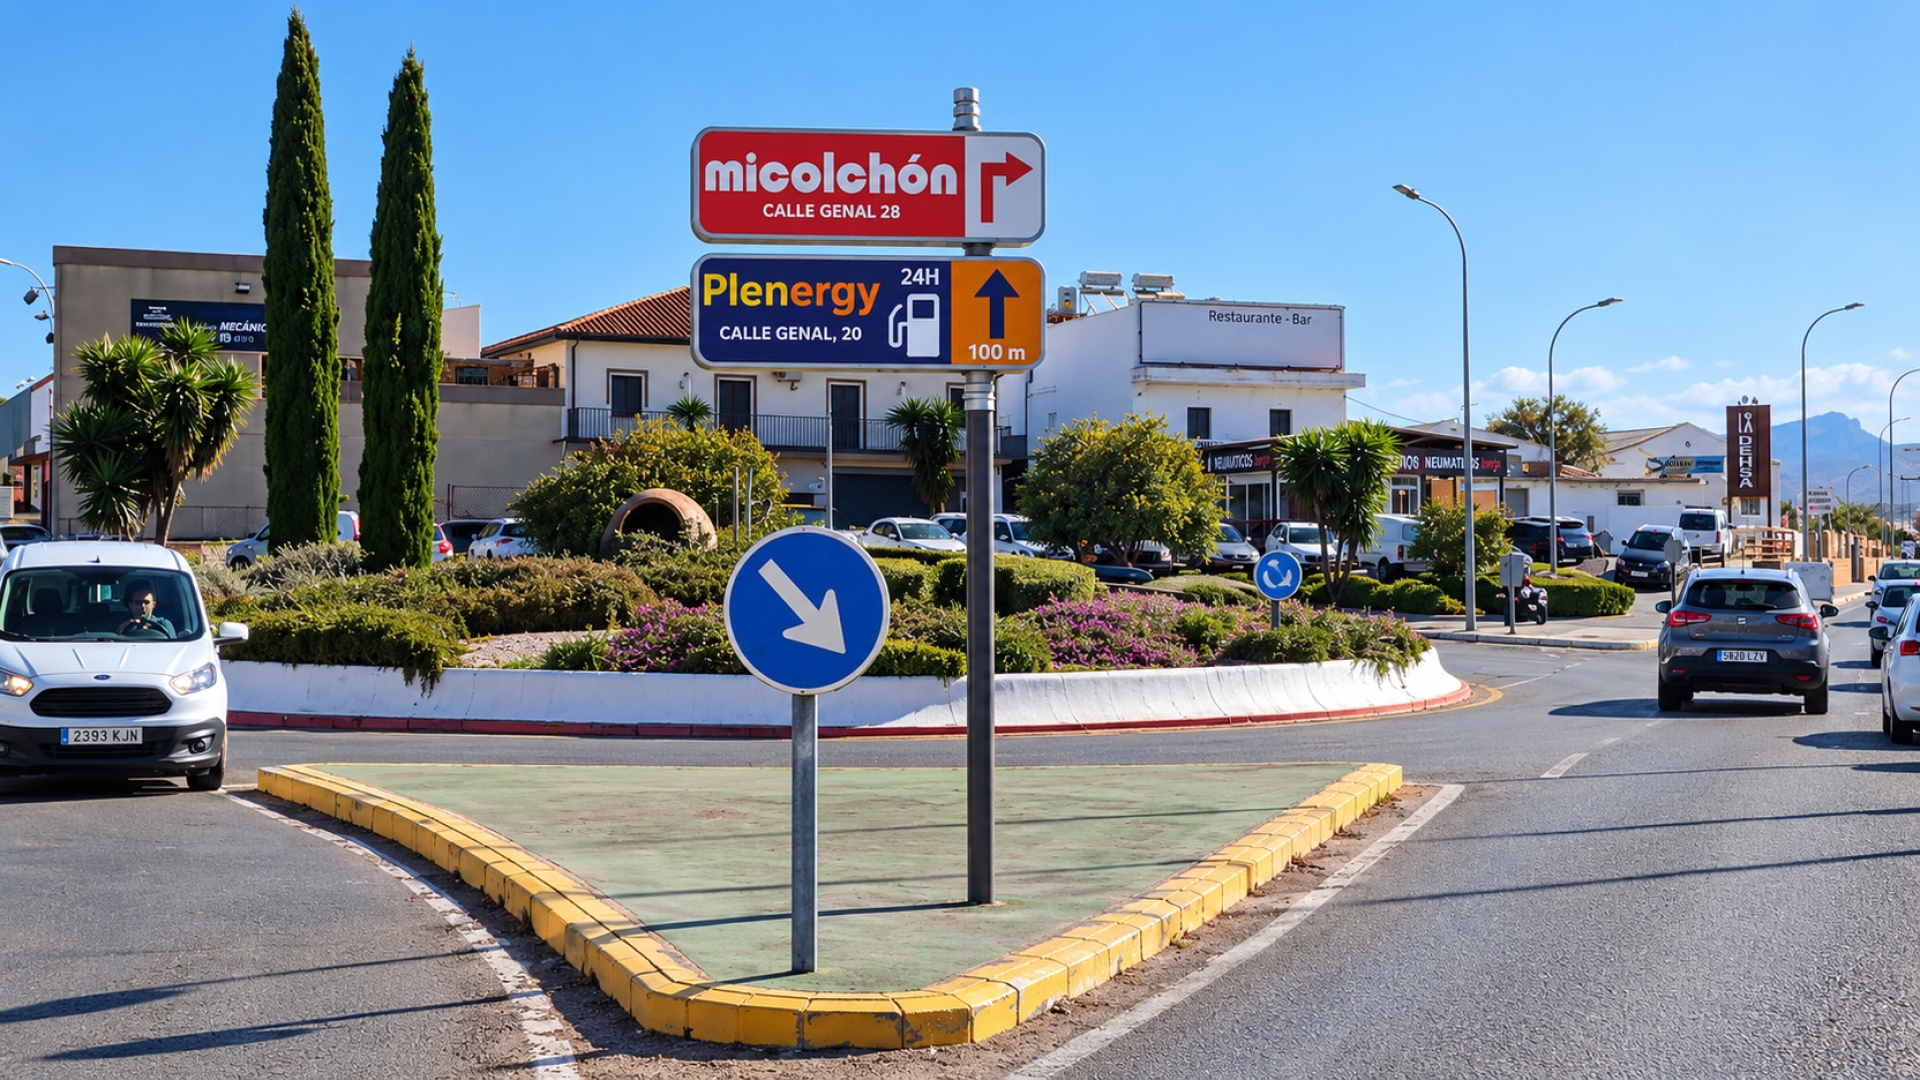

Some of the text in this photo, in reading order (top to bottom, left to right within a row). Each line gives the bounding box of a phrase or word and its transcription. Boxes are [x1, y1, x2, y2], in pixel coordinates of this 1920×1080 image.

[704, 152, 958, 195] micolchón
[763, 203, 901, 219] CALLE GENAL 28
[901, 268, 940, 286] 24H
[703, 273, 881, 317] Plenergy
[1209, 310, 1282, 324] Restaurante
[1292, 313, 1312, 325] Bar
[219, 320, 267, 333] MECÁNIC
[719, 326, 862, 343] CALLE GENAL, 20
[968, 344, 1026, 361] 100 m
[1425, 456, 1480, 470] NEUMATIOS
[73, 730, 138, 742] 2393 KJN
